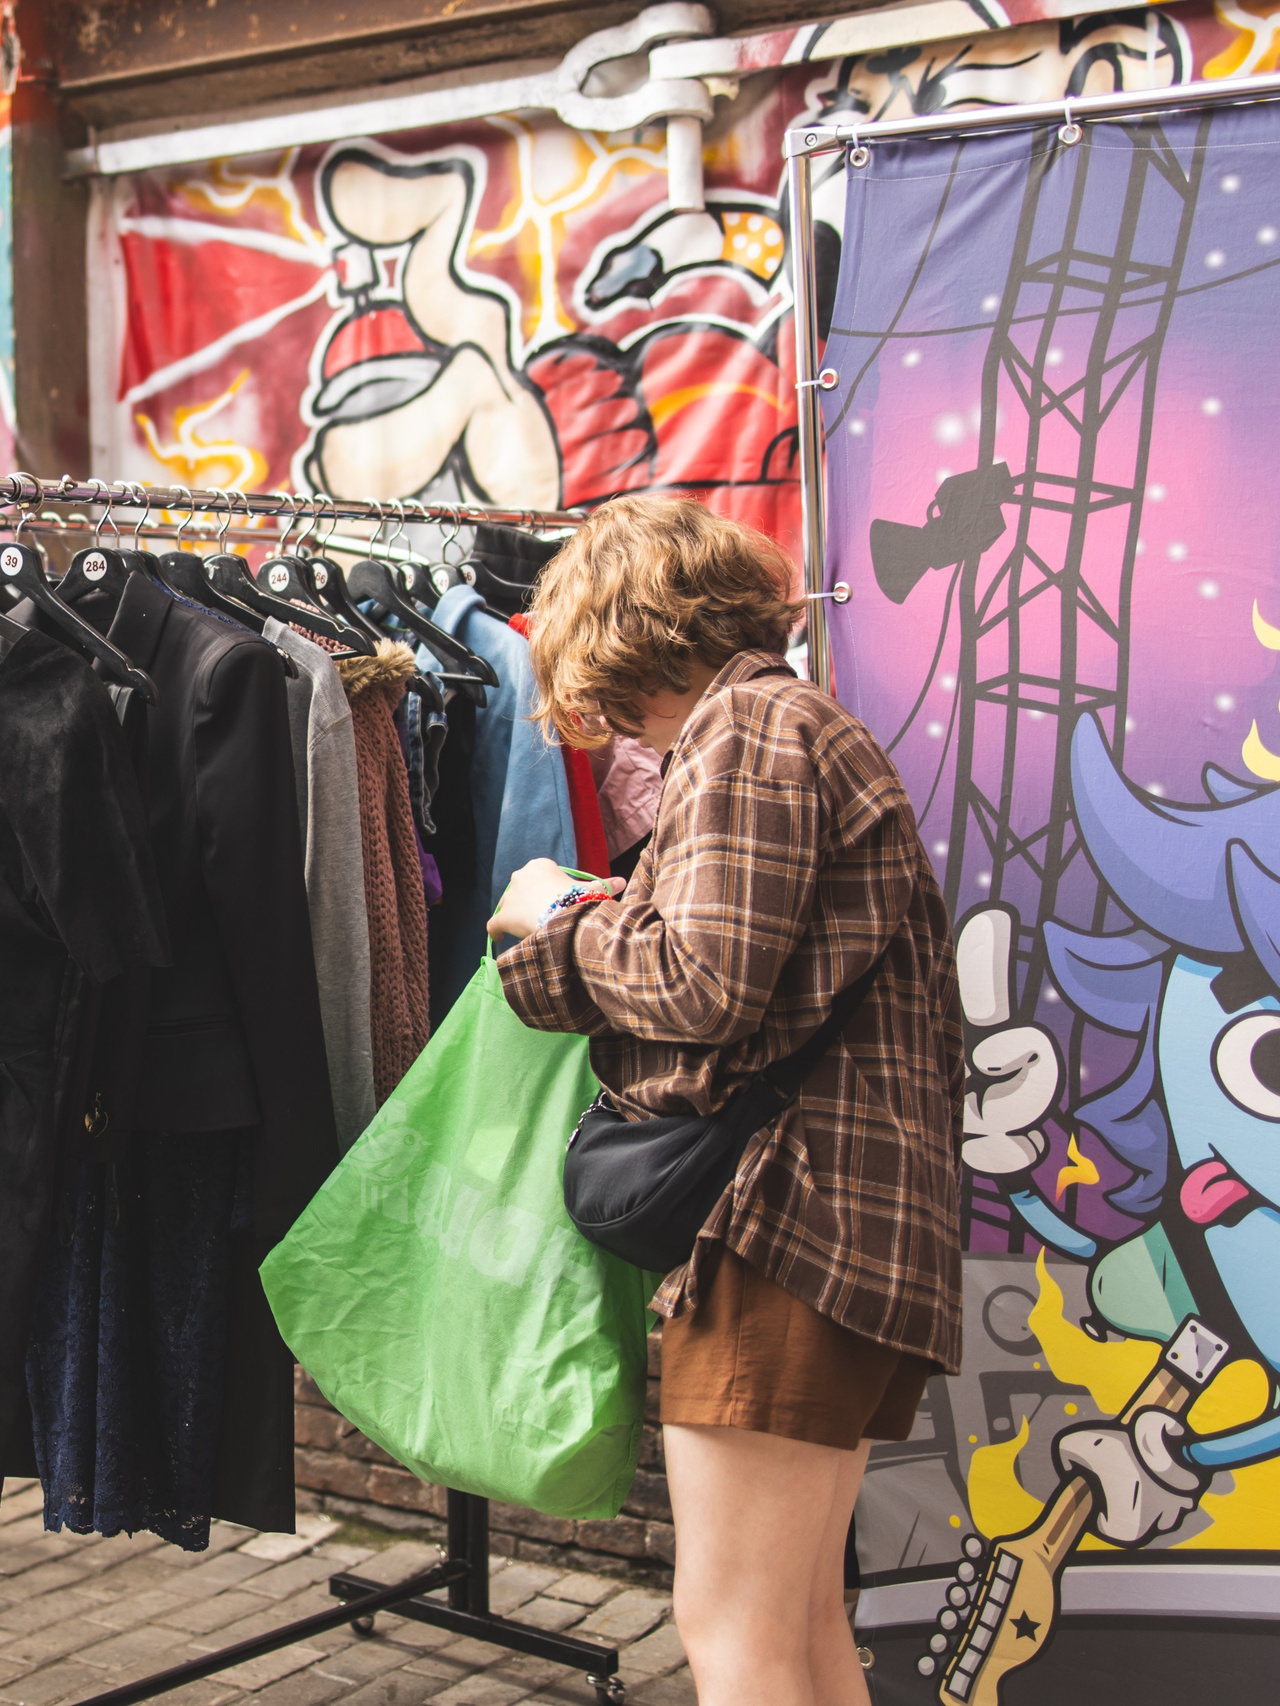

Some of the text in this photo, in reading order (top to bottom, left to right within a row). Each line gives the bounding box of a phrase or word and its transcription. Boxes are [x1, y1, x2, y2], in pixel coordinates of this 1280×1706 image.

[5, 555, 18, 568] 39
[85, 560, 105, 572] 284
[271, 572, 287, 584] 244
